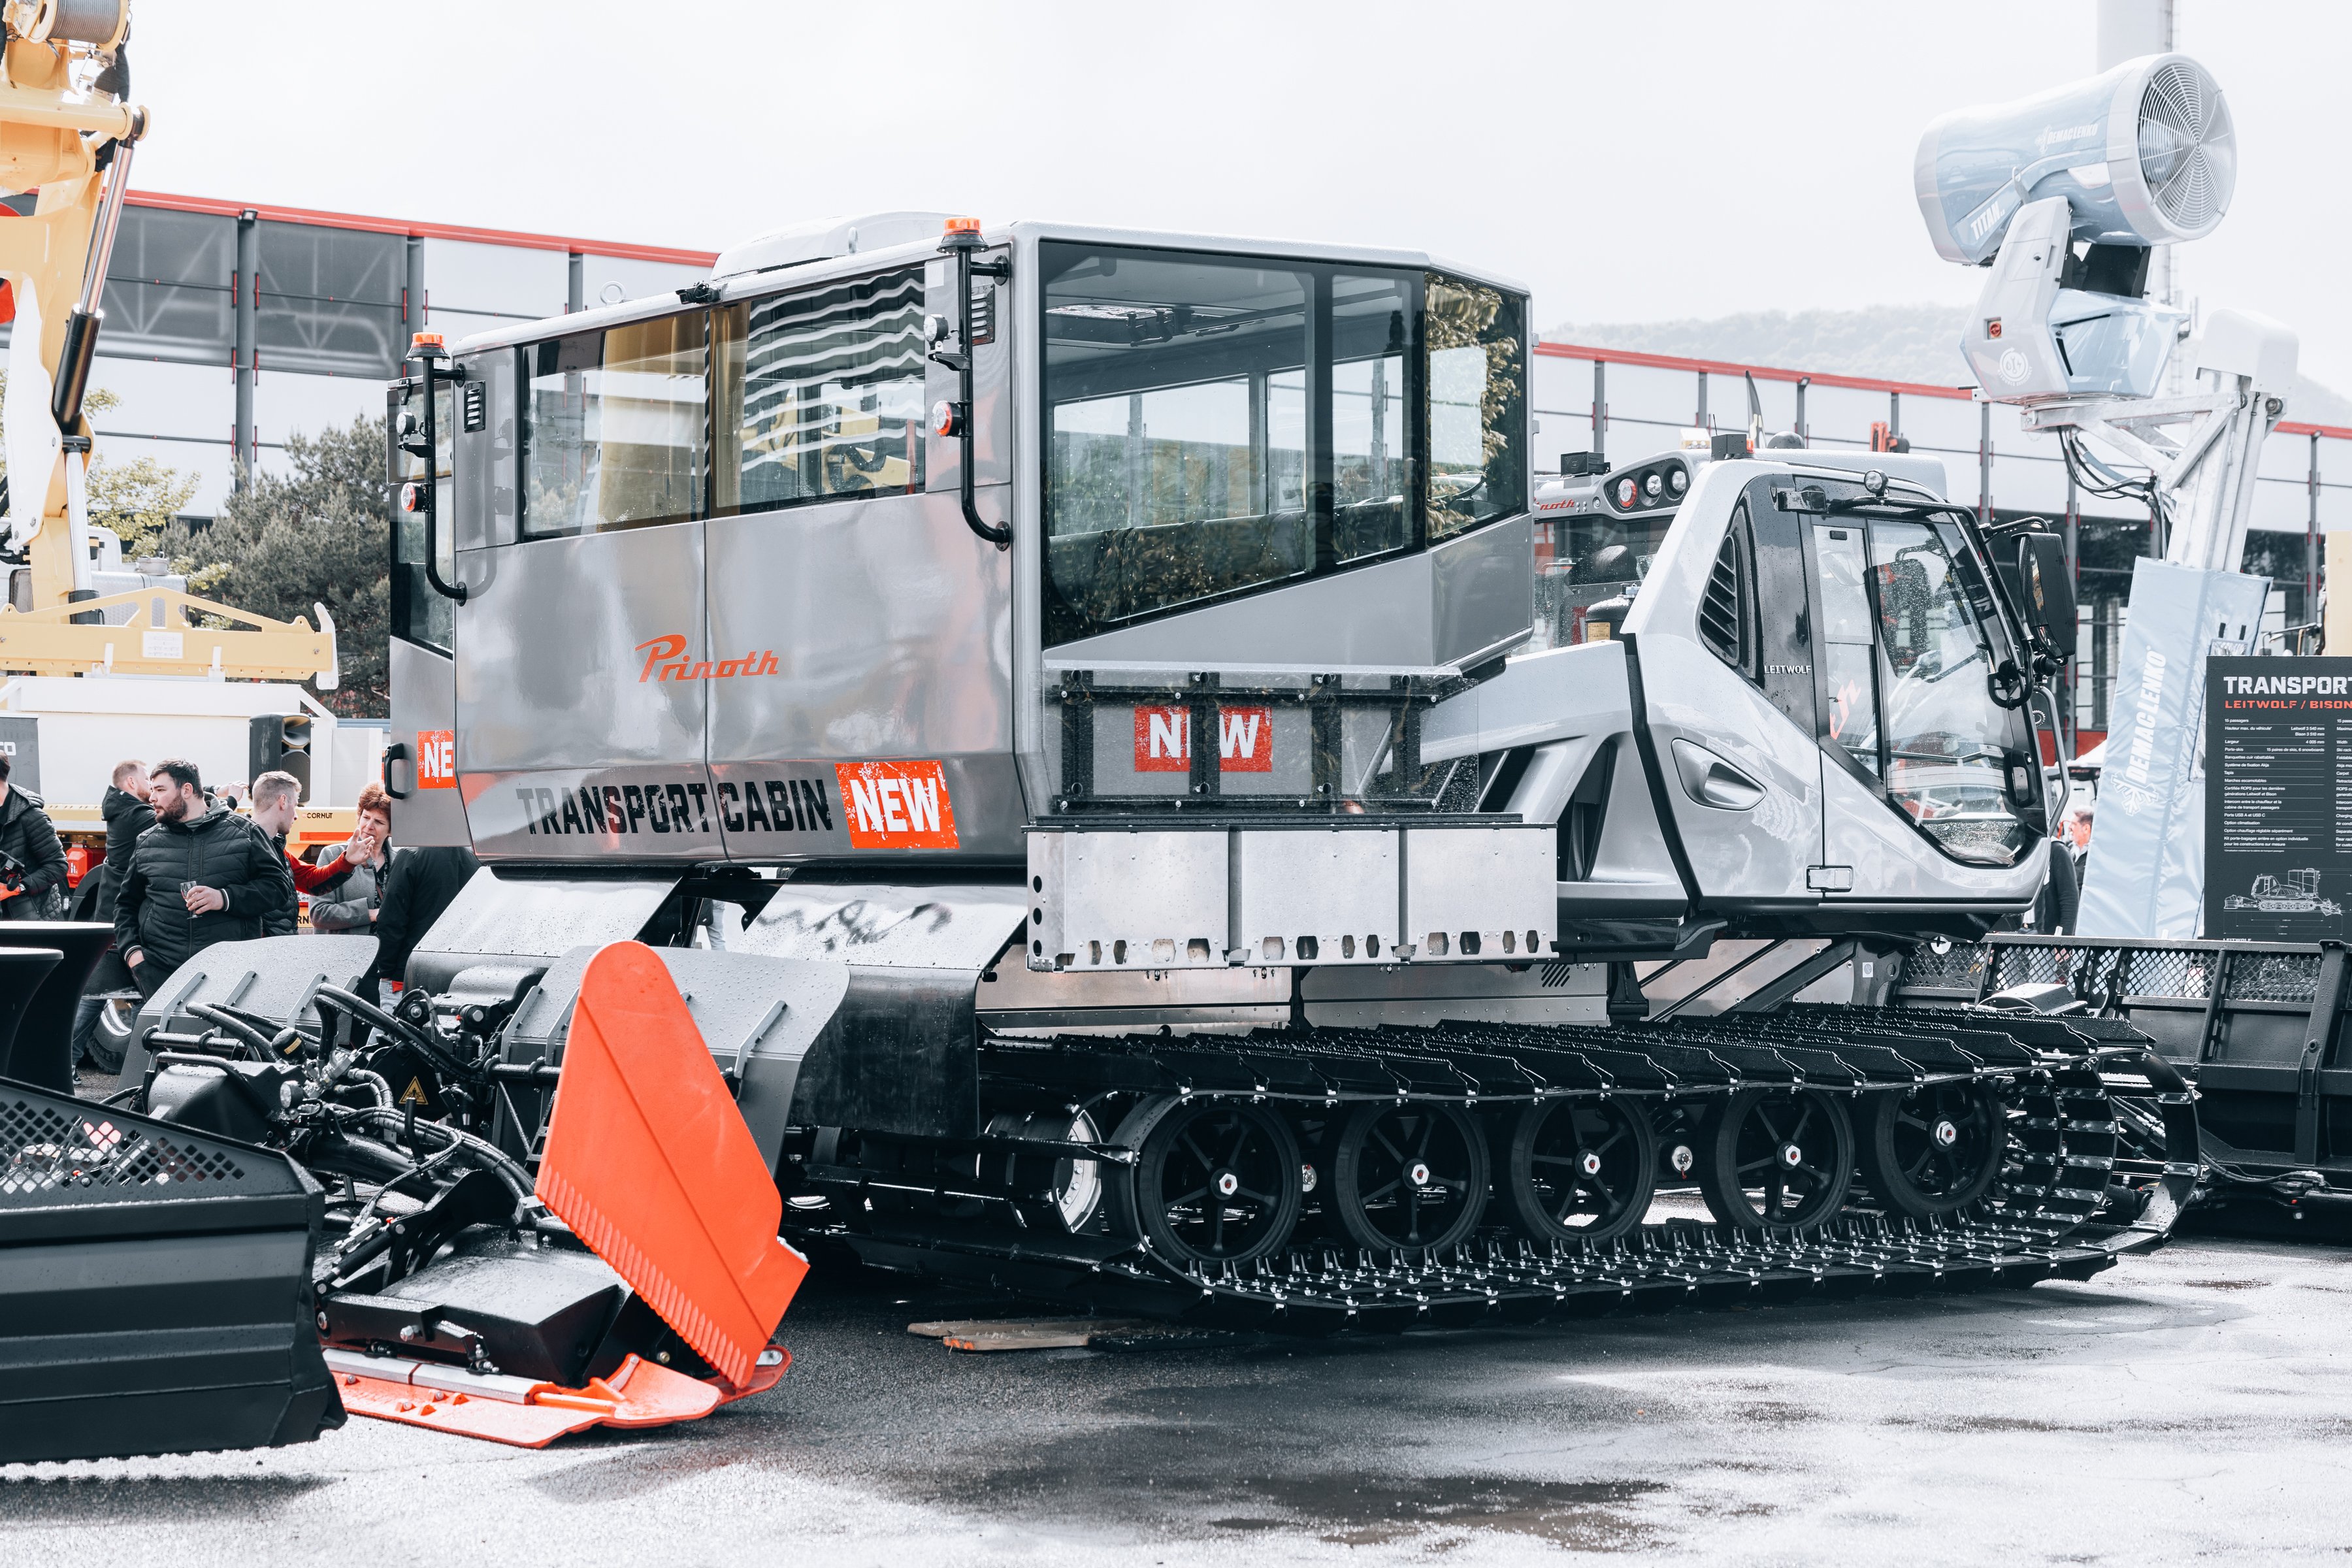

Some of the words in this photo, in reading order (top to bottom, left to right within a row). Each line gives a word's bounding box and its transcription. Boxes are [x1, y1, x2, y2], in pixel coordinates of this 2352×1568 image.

[2047, 123, 2098, 144] DEMACLENKO
[1970, 201, 2000, 240] TITAN
[635, 634, 779, 683] Prinoth
[1764, 665, 1811, 674] LEITWOLF
[2126, 651, 2166, 784] DEMACLENKO
[2225, 700, 2297, 709] LEITWOLF
[2300, 700, 2306, 710] /
[2310, 700, 2352, 709] BISON
[424, 742, 453, 778] NE
[515, 783, 710, 835] TRANSPORT
[717, 779, 833, 832] CABIN
[849, 777, 941, 833] NEW
